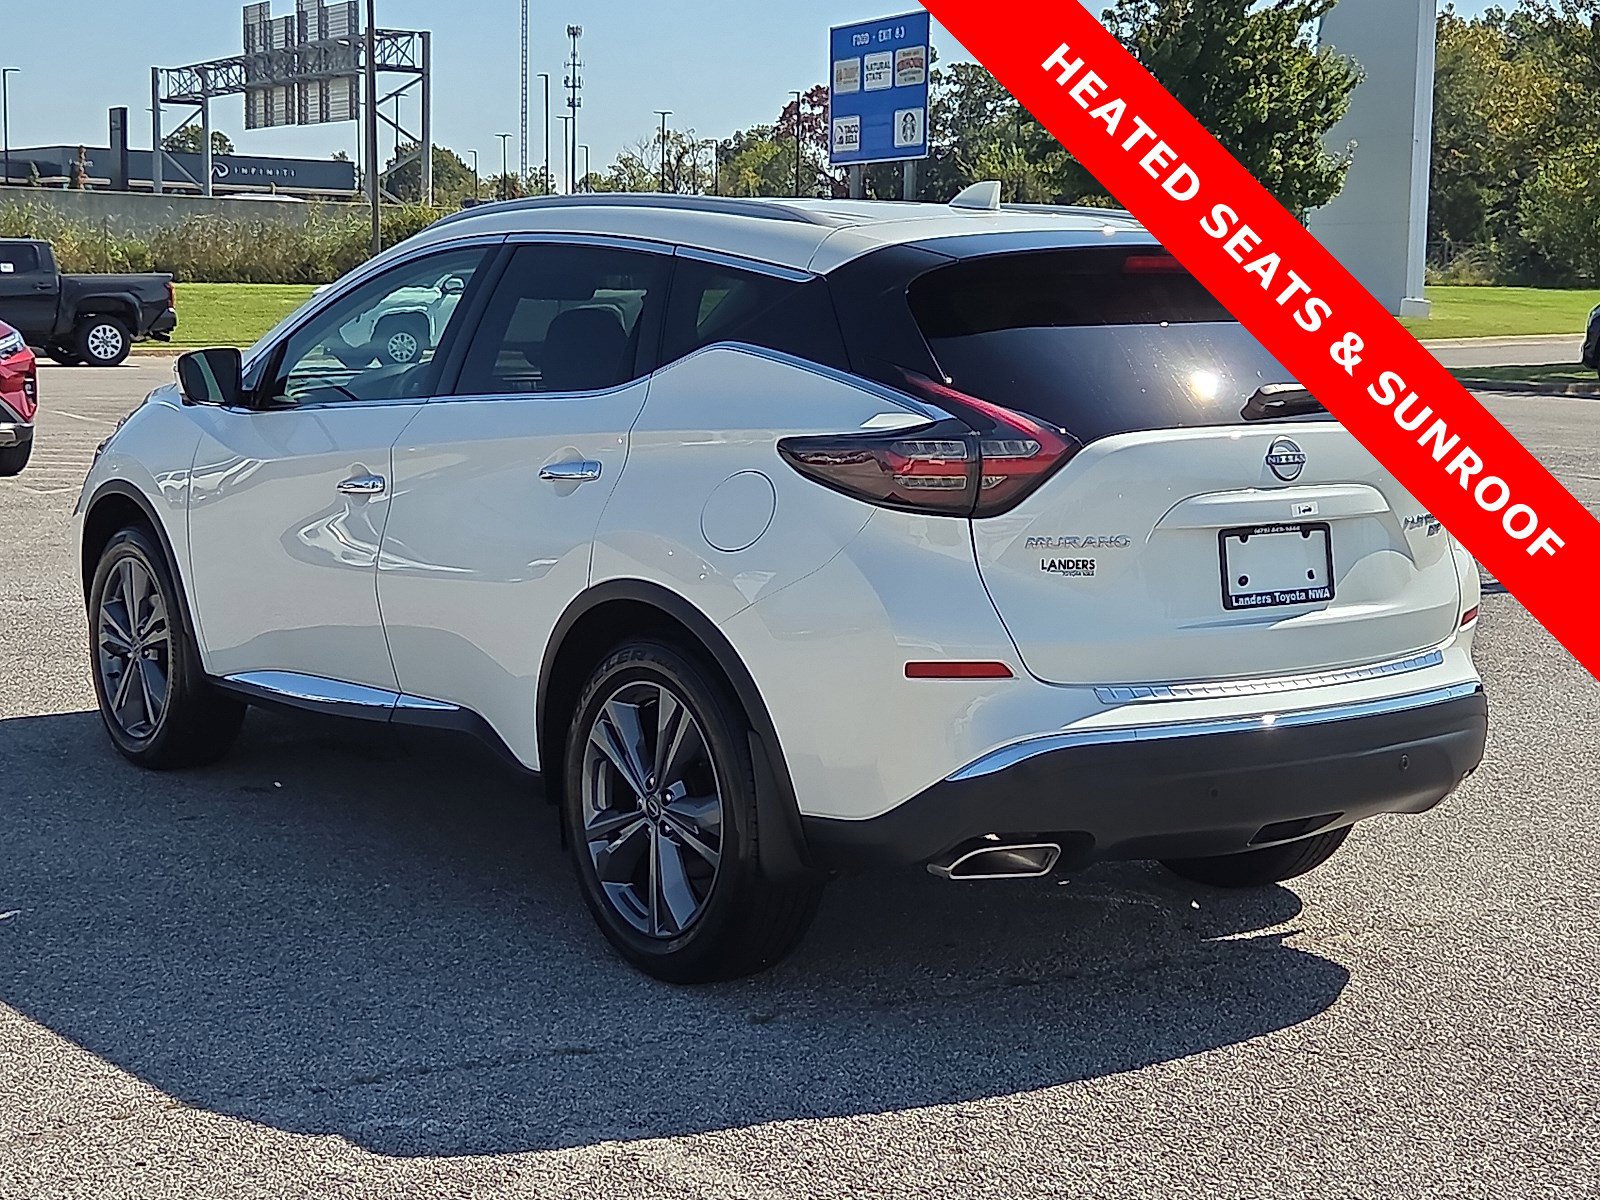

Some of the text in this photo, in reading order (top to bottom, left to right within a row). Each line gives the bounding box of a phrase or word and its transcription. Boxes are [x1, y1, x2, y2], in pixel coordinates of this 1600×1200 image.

[852, 33, 870, 46] FOOD
[878, 28, 892, 42] EXIT
[865, 61, 891, 72] NATURAL
[844, 125, 858, 134] TACO
[234, 167, 297, 177] INFINITI
[1024, 535, 1131, 549] MURANO
[1041, 559, 1096, 572] LANDERS
[1232, 588, 1331, 607] Landers Toyota NWA
